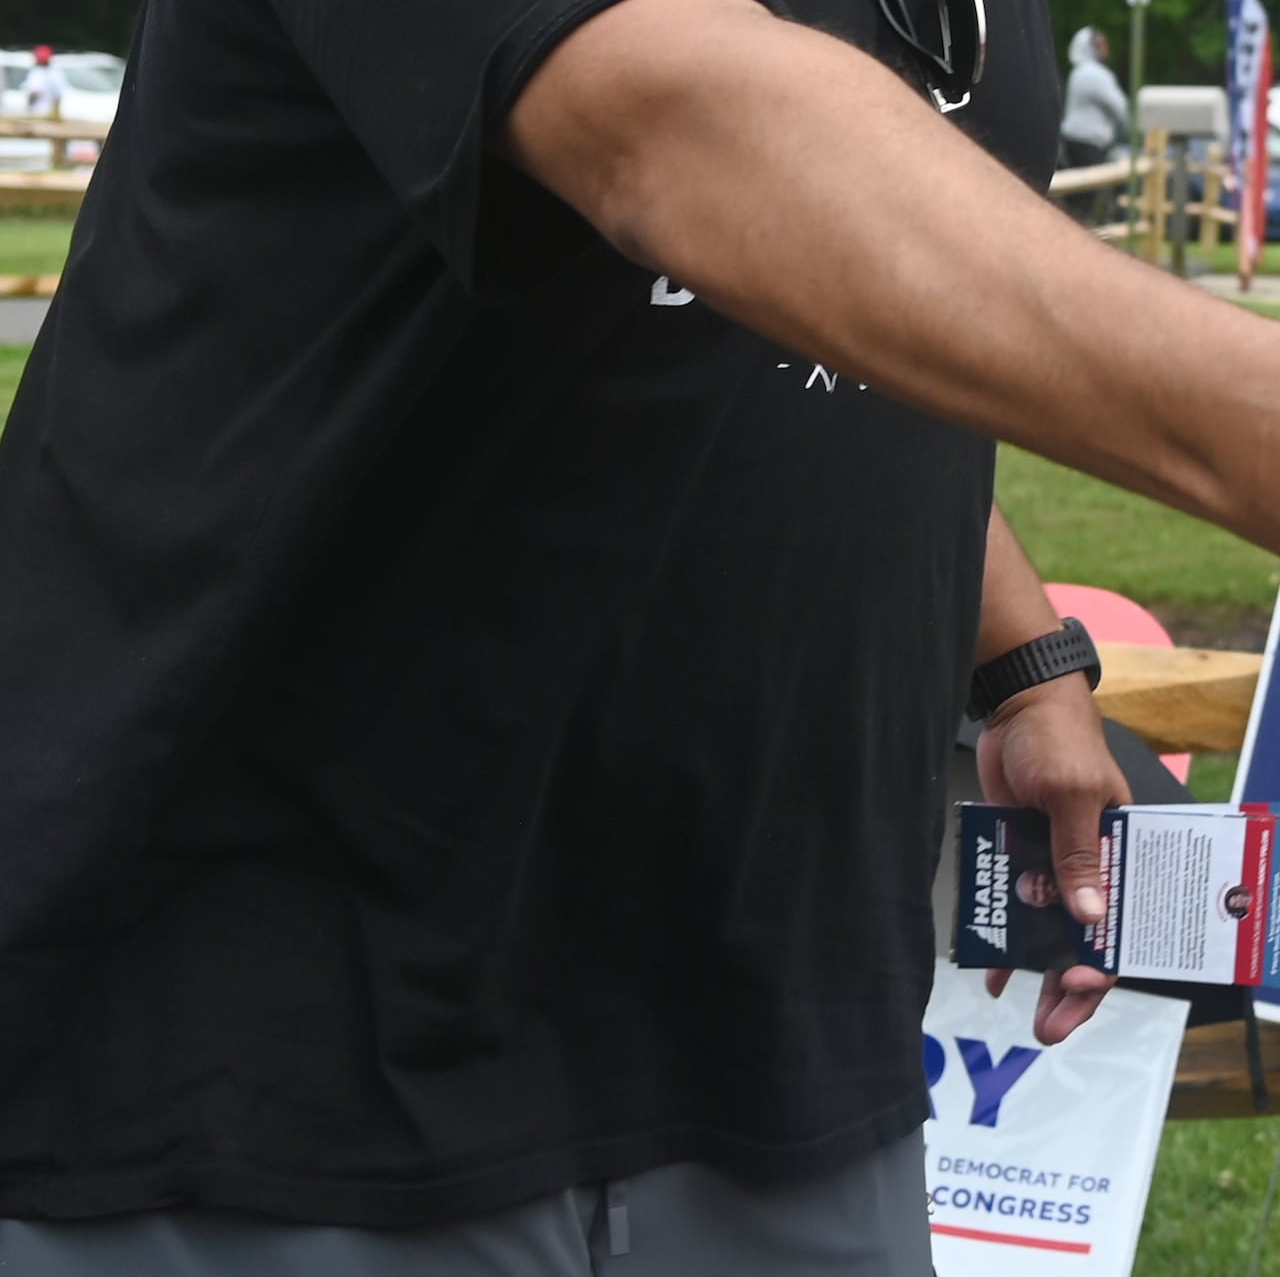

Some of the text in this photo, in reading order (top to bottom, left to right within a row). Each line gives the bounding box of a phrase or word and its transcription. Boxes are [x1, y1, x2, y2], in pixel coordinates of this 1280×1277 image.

[973, 835, 993, 925] HARRY
[991, 854, 1010, 926] DUNN
[936, 1155, 1111, 1194] DEMOCRAT FOR
[931, 1185, 1092, 1225] CONGRESS
